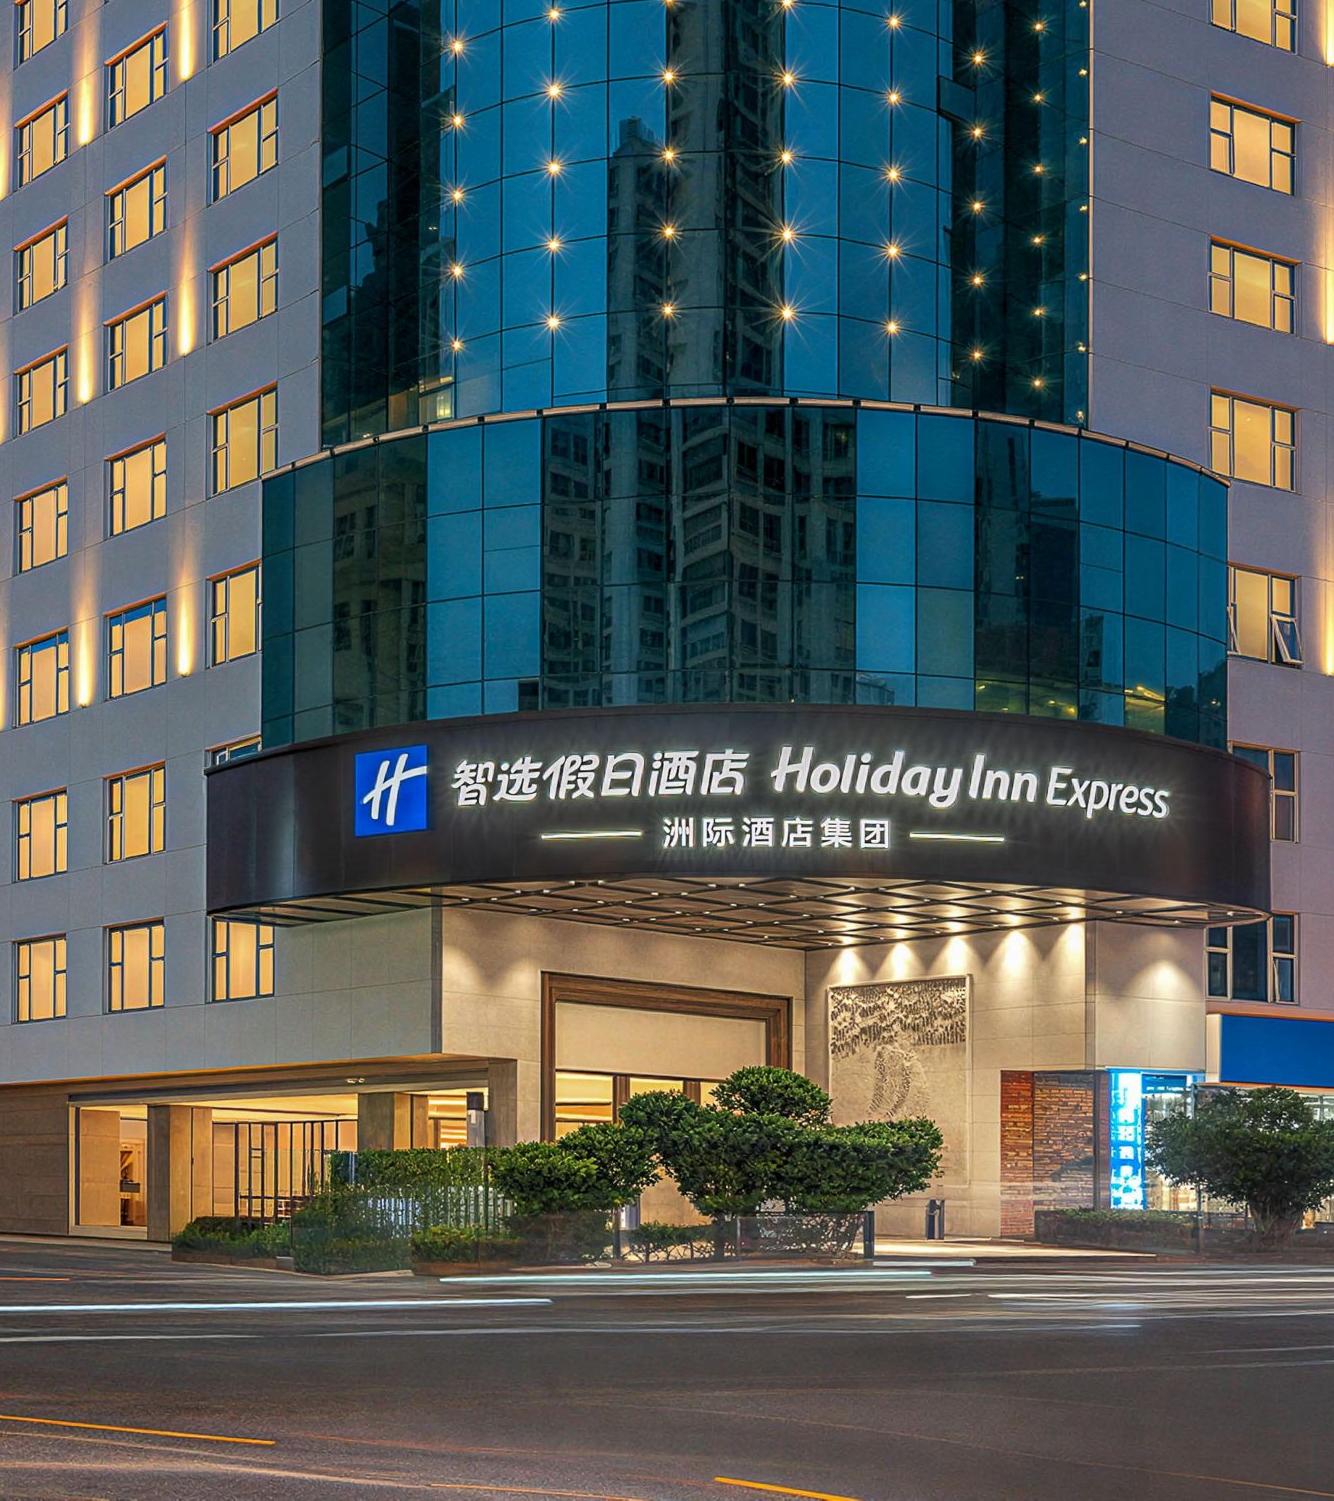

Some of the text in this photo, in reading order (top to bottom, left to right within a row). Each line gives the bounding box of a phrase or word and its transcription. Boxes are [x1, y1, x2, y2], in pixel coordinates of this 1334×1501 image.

[451, 748, 750, 807] 智选假日酒店
[770, 745, 1171, 819] Holiday Inn Express
[662, 816, 891, 850] 洲际酒店集团
